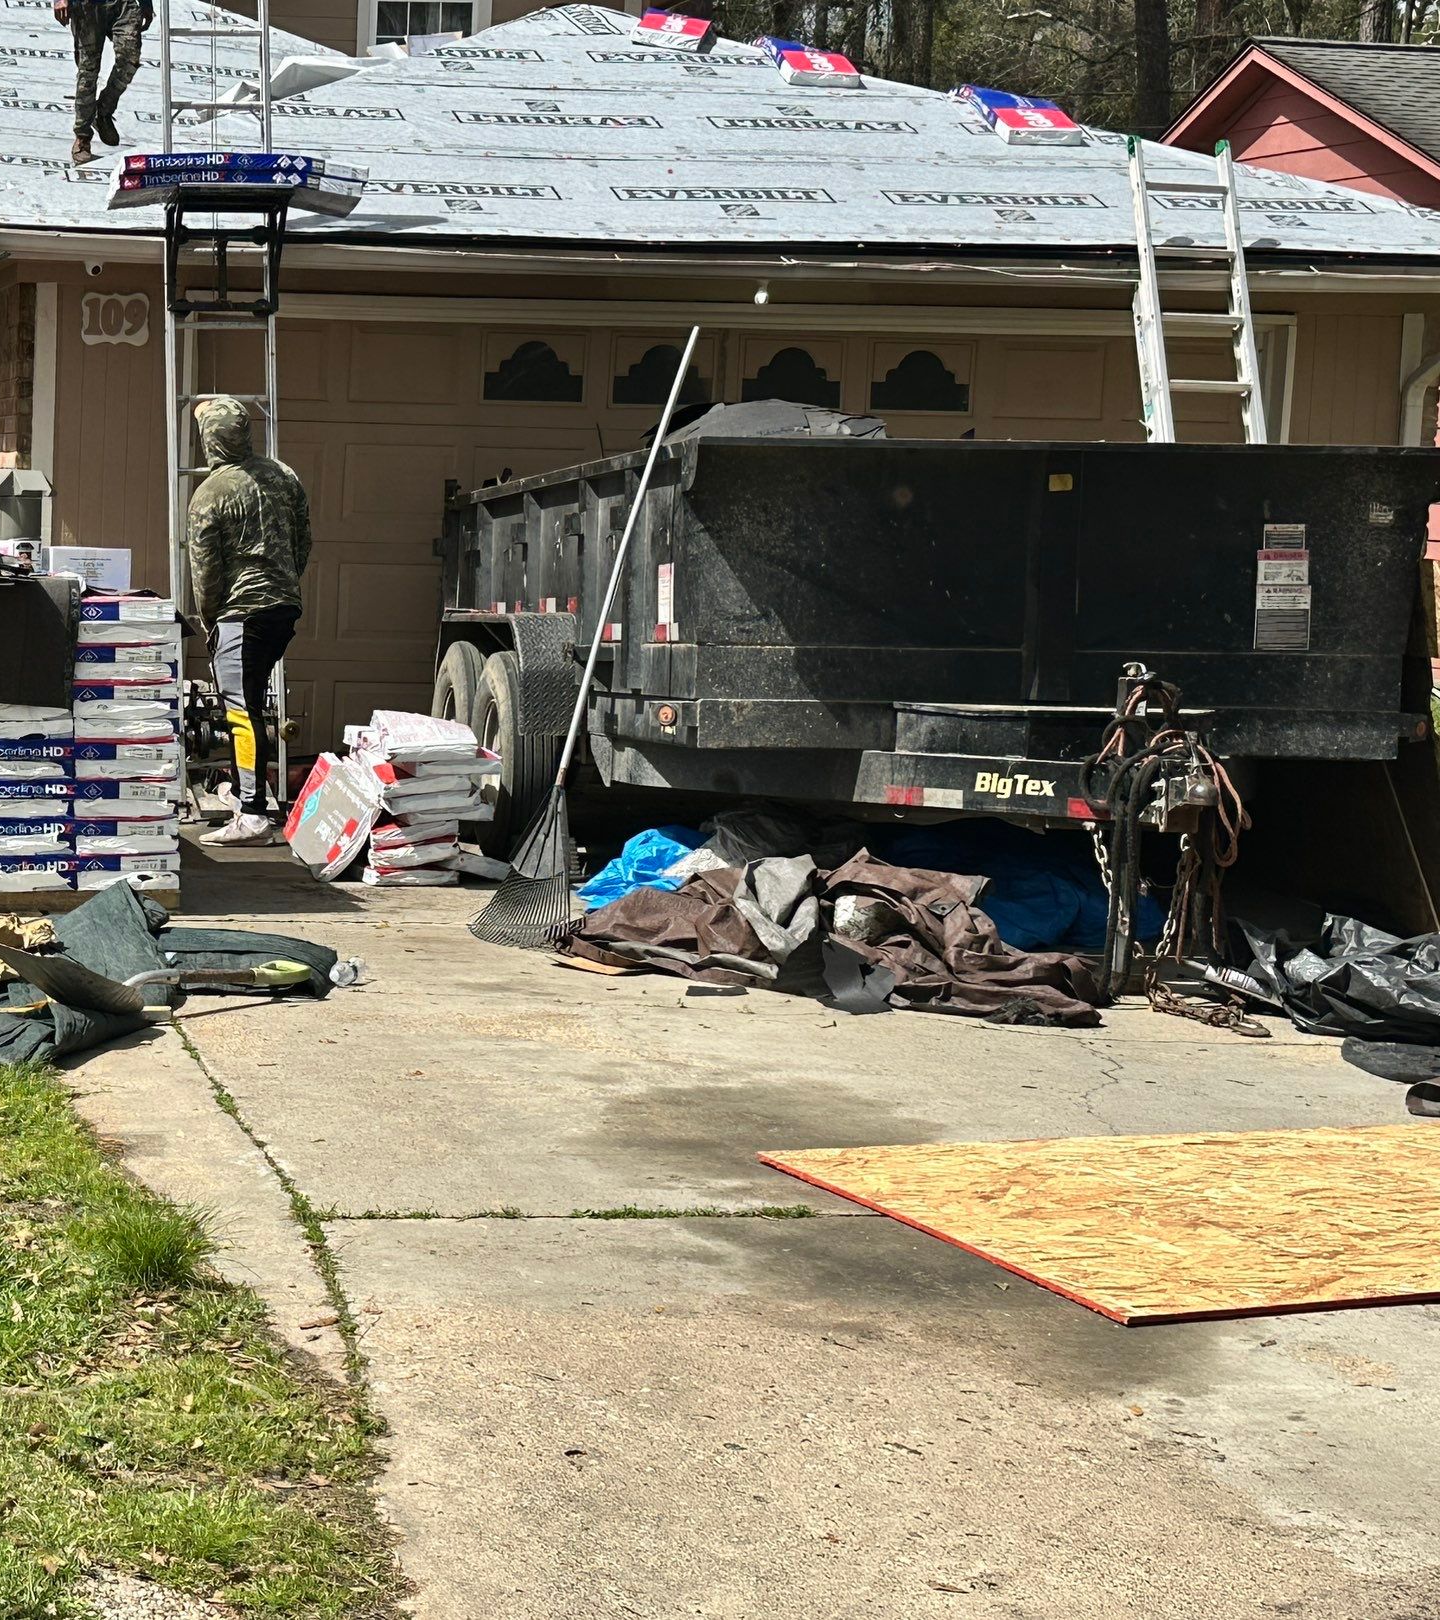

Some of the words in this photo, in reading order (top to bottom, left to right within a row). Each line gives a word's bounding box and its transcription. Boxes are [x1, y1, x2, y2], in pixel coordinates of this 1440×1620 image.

[467, 114, 652, 126] EVERBILT
[724, 119, 906, 131] EVERBILT
[622, 189, 818, 200] EVERBILT
[894, 193, 1089, 206] EVERBILT
[84, 298, 147, 336] 109
